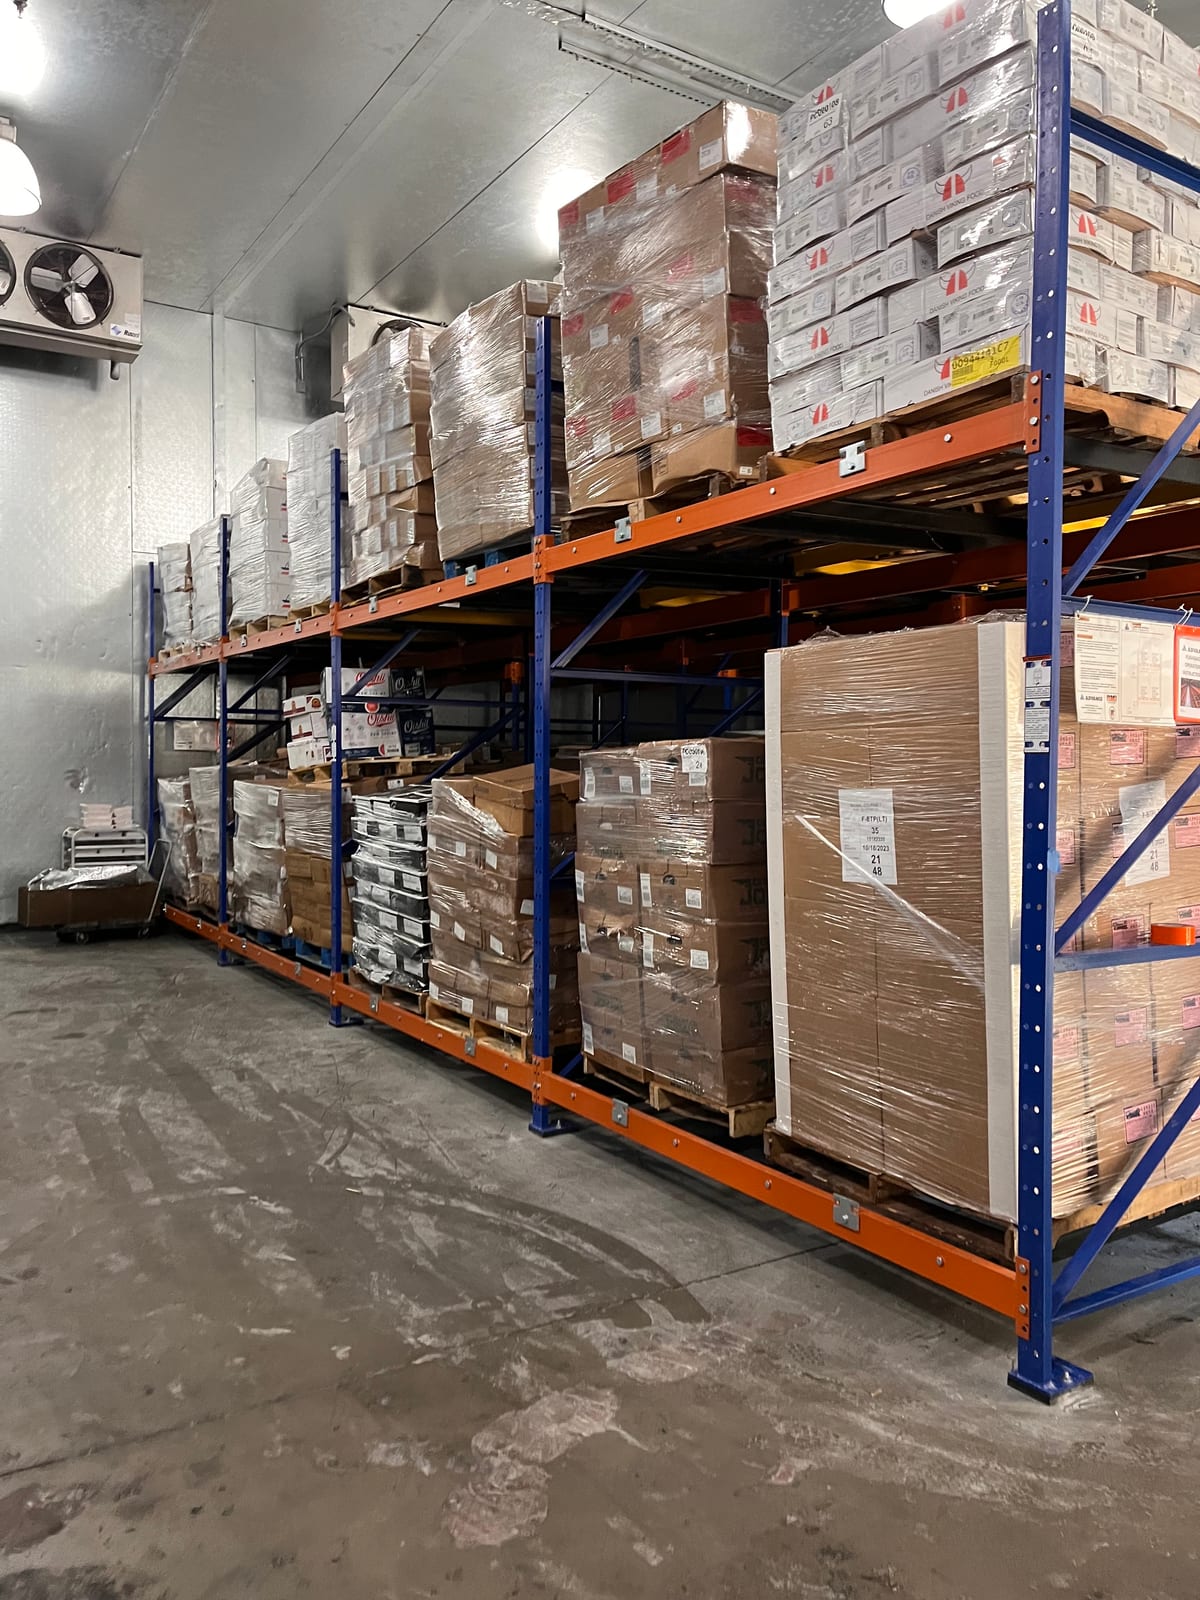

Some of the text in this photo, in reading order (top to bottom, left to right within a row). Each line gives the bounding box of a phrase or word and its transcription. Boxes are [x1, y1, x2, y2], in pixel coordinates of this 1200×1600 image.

[871, 854, 881, 864] 21
[1150, 849, 1158, 860] 21
[872, 866, 883, 876] 48
